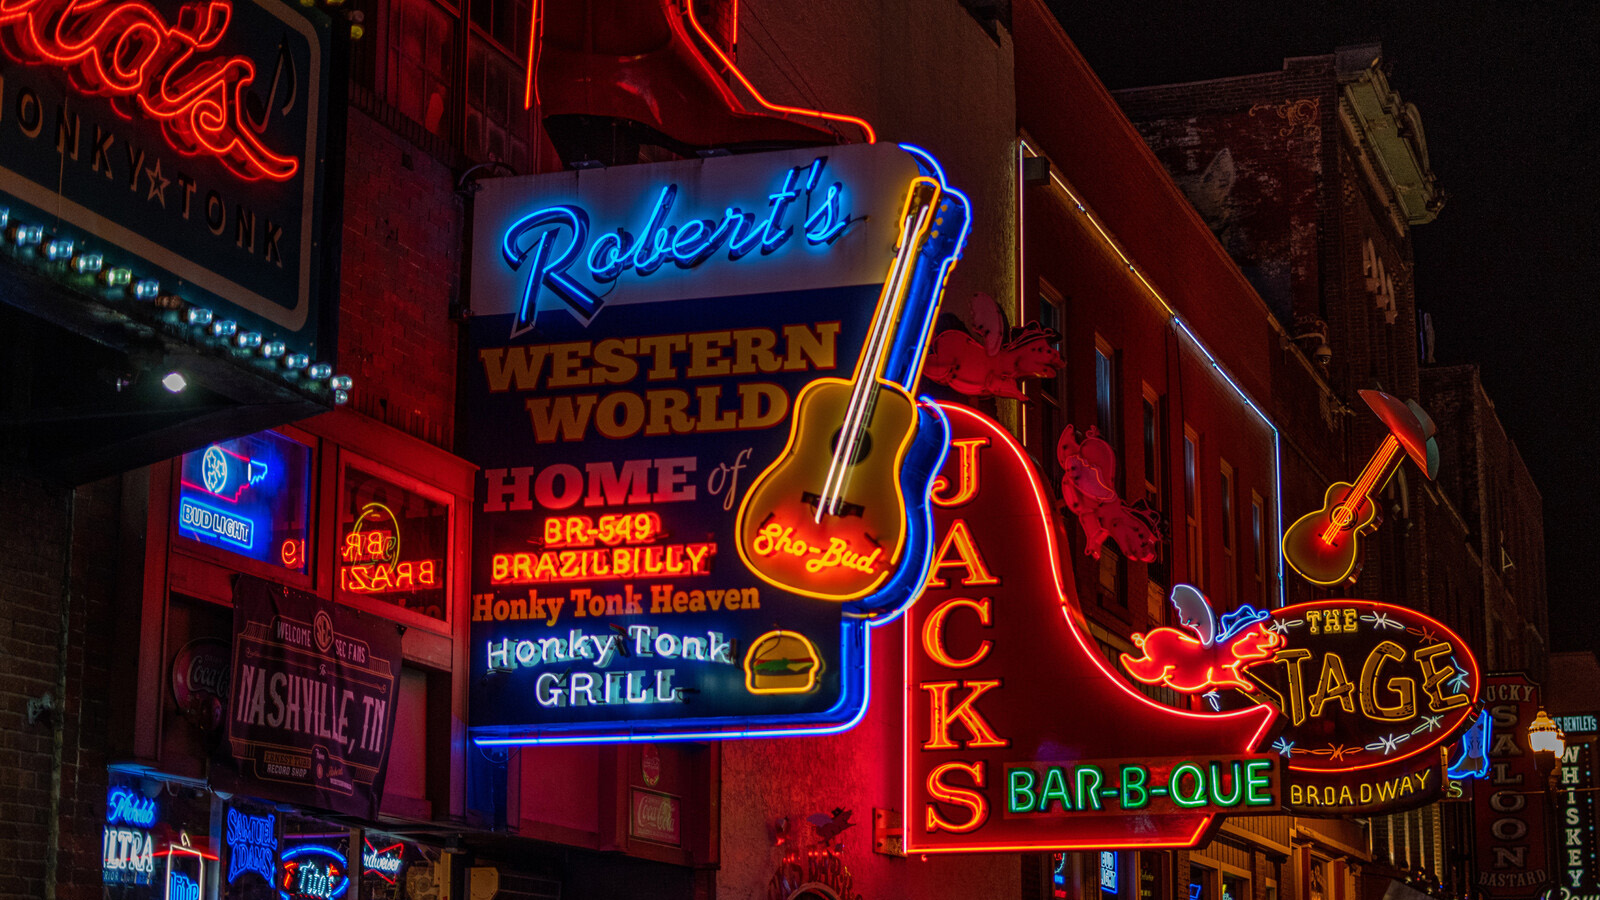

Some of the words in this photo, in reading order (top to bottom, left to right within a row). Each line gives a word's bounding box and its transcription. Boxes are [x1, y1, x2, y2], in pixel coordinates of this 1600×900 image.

[0, 76, 146, 193] ONKY
[177, 171, 284, 269] TONK
[503, 156, 850, 332] Robert's
[479, 320, 841, 393] WESTERN
[526, 382, 792, 443] WORLD
[483, 456, 698, 512] HOME
[708, 448, 753, 510] of
[182, 504, 212, 531] BUD
[213, 514, 250, 543] LIGHT
[544, 511, 661, 548] BR-549
[491, 543, 714, 585] BRAZILBILLY
[753, 522, 884, 575] Sho-Bud
[472, 592, 566, 627] Honky
[570, 585, 643, 617] Tonk
[649, 583, 760, 614] Heaven
[1306, 608, 1358, 634] THE
[276, 620, 312, 648] WELCOME
[348, 643, 366, 664] FANS
[487, 628, 617, 673] Honky
[628, 624, 737, 666] Tonk
[920, 436, 1010, 836] JACKS
[236, 664, 356, 755] NASHVILLE,
[360, 694, 387, 754] TN
[535, 668, 681, 709] GRILL
[1486, 684, 1536, 702] UCKY
[266, 764, 291, 776] RECORD
[291, 767, 308, 778] SHOP
[1008, 757, 1274, 814] BAR-B-QUE
[1290, 769, 1431, 806] BROADWAY
[1490, 704, 1527, 868] SALOON
[226, 806, 278, 850] SAMUEL
[1561, 745, 1584, 888] WHISKEY
[227, 844, 277, 889] ADAMS
[1478, 868, 1548, 887] BASTARD
